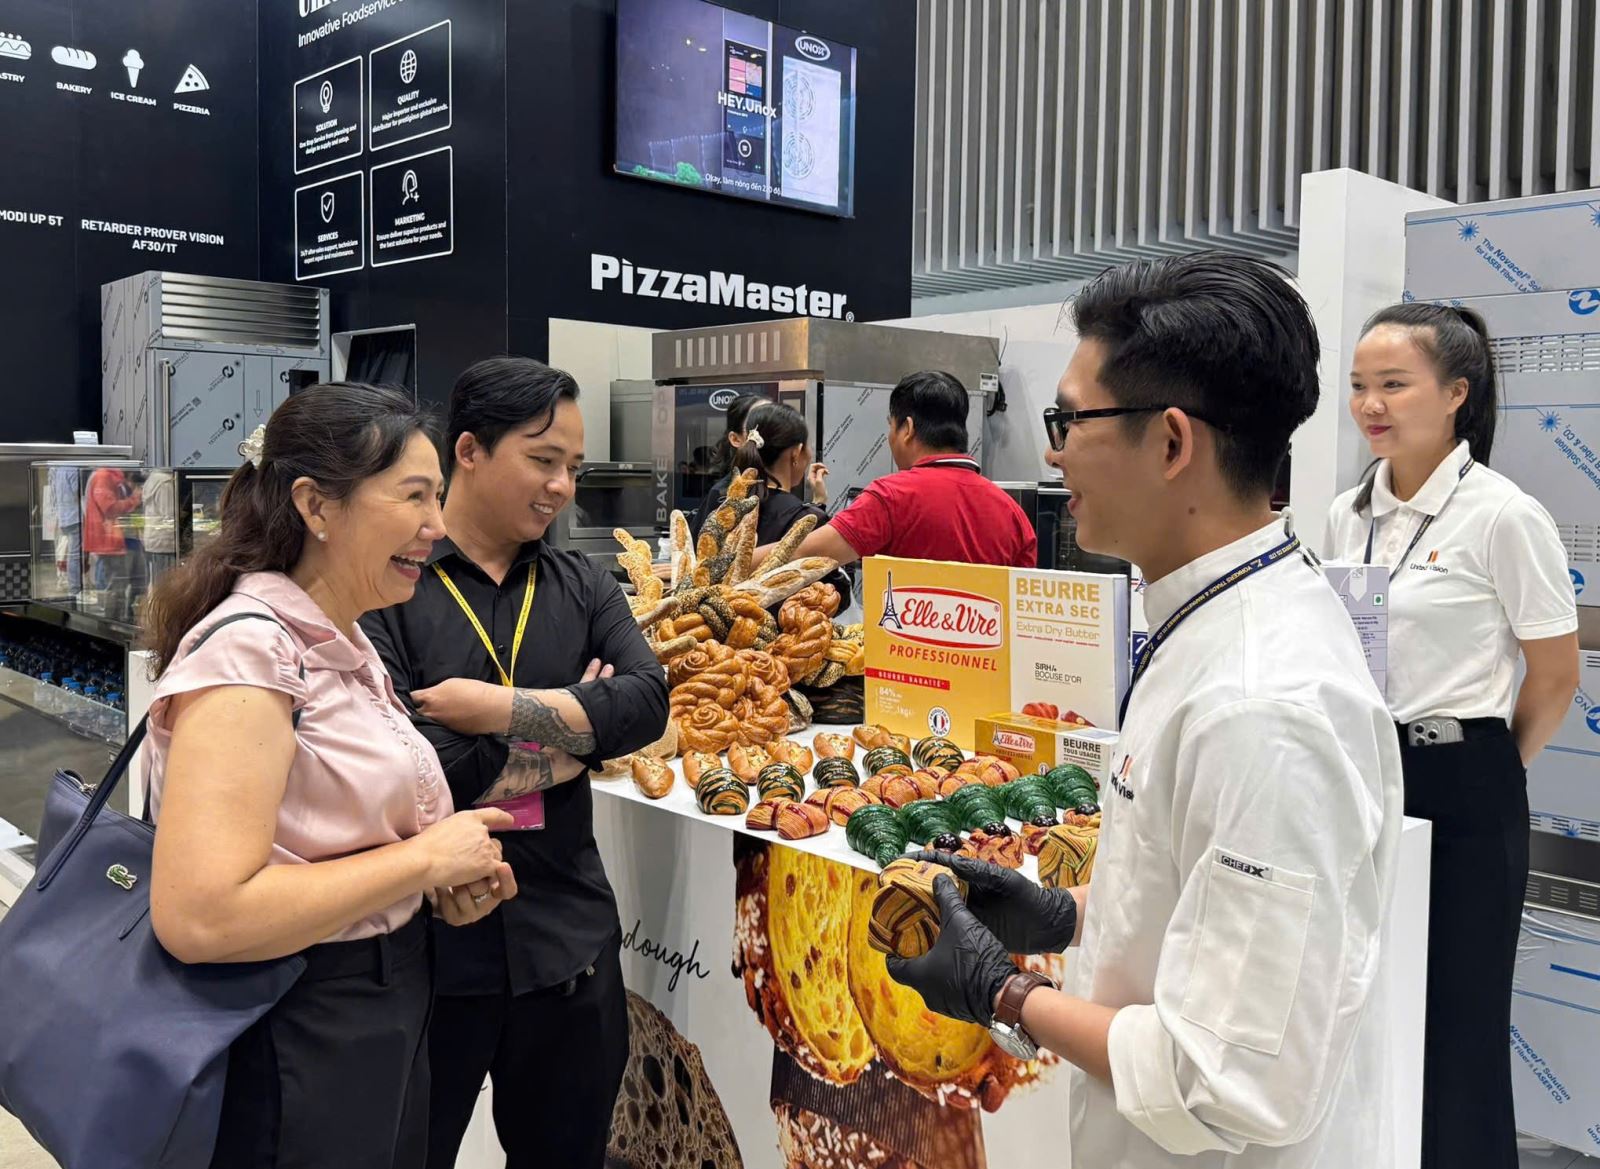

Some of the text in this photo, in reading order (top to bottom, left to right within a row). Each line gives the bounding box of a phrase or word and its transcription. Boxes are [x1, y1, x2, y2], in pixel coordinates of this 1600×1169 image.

[298, 18, 340, 48] Innovative
[342, 0, 397, 28] Foodservice
[800, 39, 828, 56] UNOX
[0, 72, 25, 82] STRY
[56, 82, 92, 94] BAKERY
[110, 92, 156, 106] ICE CREAM
[397, 89, 420, 106] QUALITY
[173, 103, 210, 116] PIZZERIA
[316, 118, 338, 133] SOLUTION
[30, 213, 46, 224] UP
[48, 215, 64, 226] 5T
[394, 212, 426, 226] MARKETING
[81, 218, 224, 246] RETARDER PROVER VISION
[318, 231, 338, 243] SERVICES
[1480, 238, 1495, 252] The
[1492, 247, 1527, 280] Novacel
[1482, 252, 1502, 270] LASER
[1499, 268, 1516, 283] Fiber
[591, 253, 848, 319] PizzaMaster
[1554, 437, 1582, 466] Solution
[1580, 445, 1598, 464] Fiber
[1016, 578, 1100, 603] BEURRE
[1016, 599, 1100, 620] EXTRA SEC
[1016, 622, 1042, 632] Extra
[1045, 624, 1062, 636] Dry
[1066, 627, 1100, 640] Butter
[890, 644, 997, 672] PROFESSIONNEL
[878, 671, 905, 682] BEURRE
[1035, 670, 1063, 681] BOCUSE
[1064, 674, 1082, 684] D'OR
[1063, 738, 1101, 752] BEURRE
[1064, 748, 1100, 760] TOUS USAGES
[620, 920, 710, 992] dough
[1532, 1067, 1552, 1091] LASER
[1543, 1067, 1571, 1102] Solution
